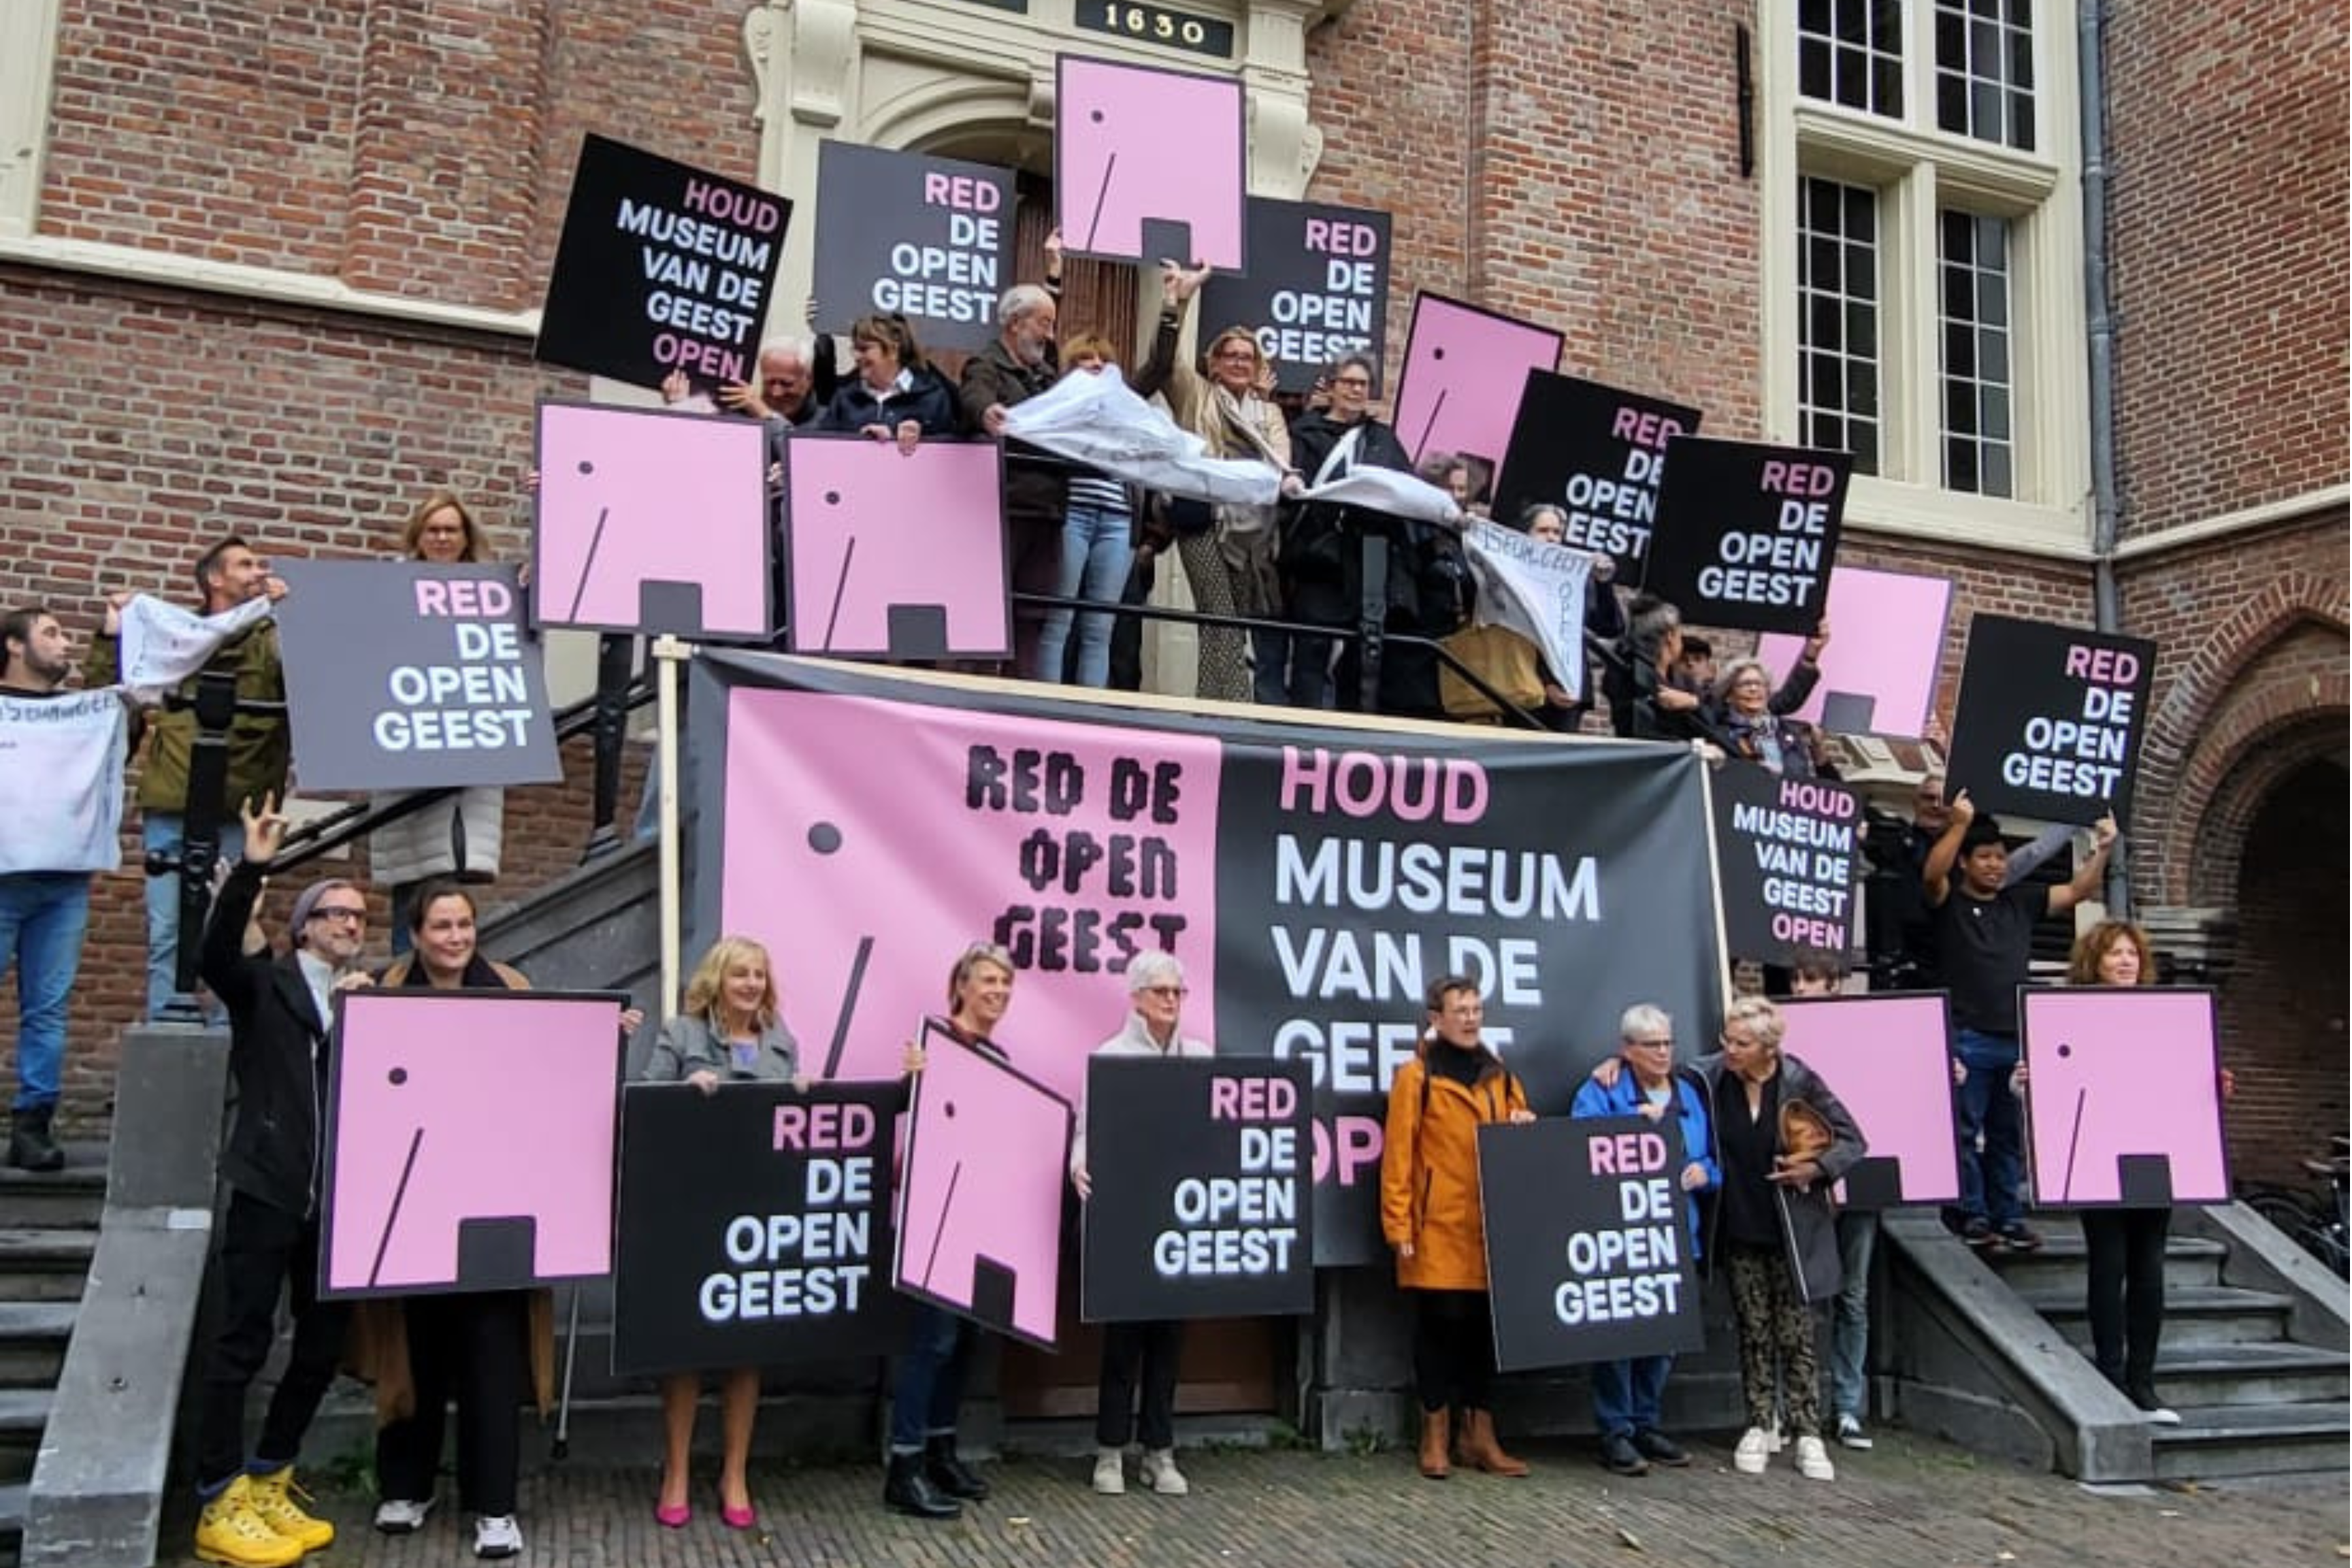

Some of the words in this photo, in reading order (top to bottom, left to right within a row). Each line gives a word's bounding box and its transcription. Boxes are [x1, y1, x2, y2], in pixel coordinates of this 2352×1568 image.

[1107, 4, 1204, 44] 1630
[684, 179, 779, 233] HOUD
[926, 172, 1000, 212] RED
[617, 199, 770, 272] MUSEUM
[950, 213, 998, 251] DE
[1305, 219, 1377, 257] RED
[643, 246, 710, 293] VAN
[717, 270, 762, 310] DE
[892, 243, 997, 287] OPEN
[1327, 259, 1375, 295] DE
[647, 291, 754, 344] GEEST
[872, 278, 998, 324] GEEST
[1271, 291, 1371, 332] OPEN
[653, 333, 744, 381] OPEN
[1613, 408, 1682, 451] RED
[1566, 474, 1656, 523] OPEN
[1761, 461, 1834, 496] RED
[1565, 512, 1651, 558] EEST
[1779, 500, 1829, 534] DE
[1720, 532, 1820, 571] OPEN
[416, 580, 511, 617] RED
[1698, 566, 1816, 606] GEEST
[455, 623, 521, 660] DE
[390, 666, 527, 705] OPEN
[2065, 645, 2139, 685] RED
[2083, 687, 2134, 724] DE
[374, 709, 532, 751] GEEST
[2025, 717, 2126, 762] OPEN
[965, 744, 1085, 816] RED
[1109, 756, 1183, 825] DE
[1280, 746, 1488, 823] HOUD
[2003, 753, 2122, 799] GEEST
[1780, 780, 1855, 818] HOUD
[1733, 802, 1851, 853] MUSEUM
[1019, 828, 1177, 901] OPEN
[1276, 834, 1601, 922] MUSEUM
[1754, 840, 1808, 877] VAN
[1814, 853, 1850, 886] DE
[1763, 877, 1848, 917] GEEST
[994, 904, 1186, 973] GEEST
[1772, 913, 1844, 950] OPEN
[1271, 926, 1424, 1002] VAN
[1448, 936, 1541, 1005] DE
[1211, 1078, 1296, 1120] RED
[773, 1104, 875, 1150] RED
[1241, 1128, 1296, 1171] DE
[1589, 1133, 1667, 1175] RED
[806, 1157, 873, 1204] DE
[1174, 1177, 1295, 1222] OPEN
[1620, 1178, 1673, 1221] DE
[726, 1211, 869, 1264] OPEN
[1154, 1228, 1296, 1275] GEEST
[1568, 1225, 1678, 1274] OPEN
[700, 1265, 870, 1321] GEEST
[1555, 1273, 1682, 1324] GEEST
